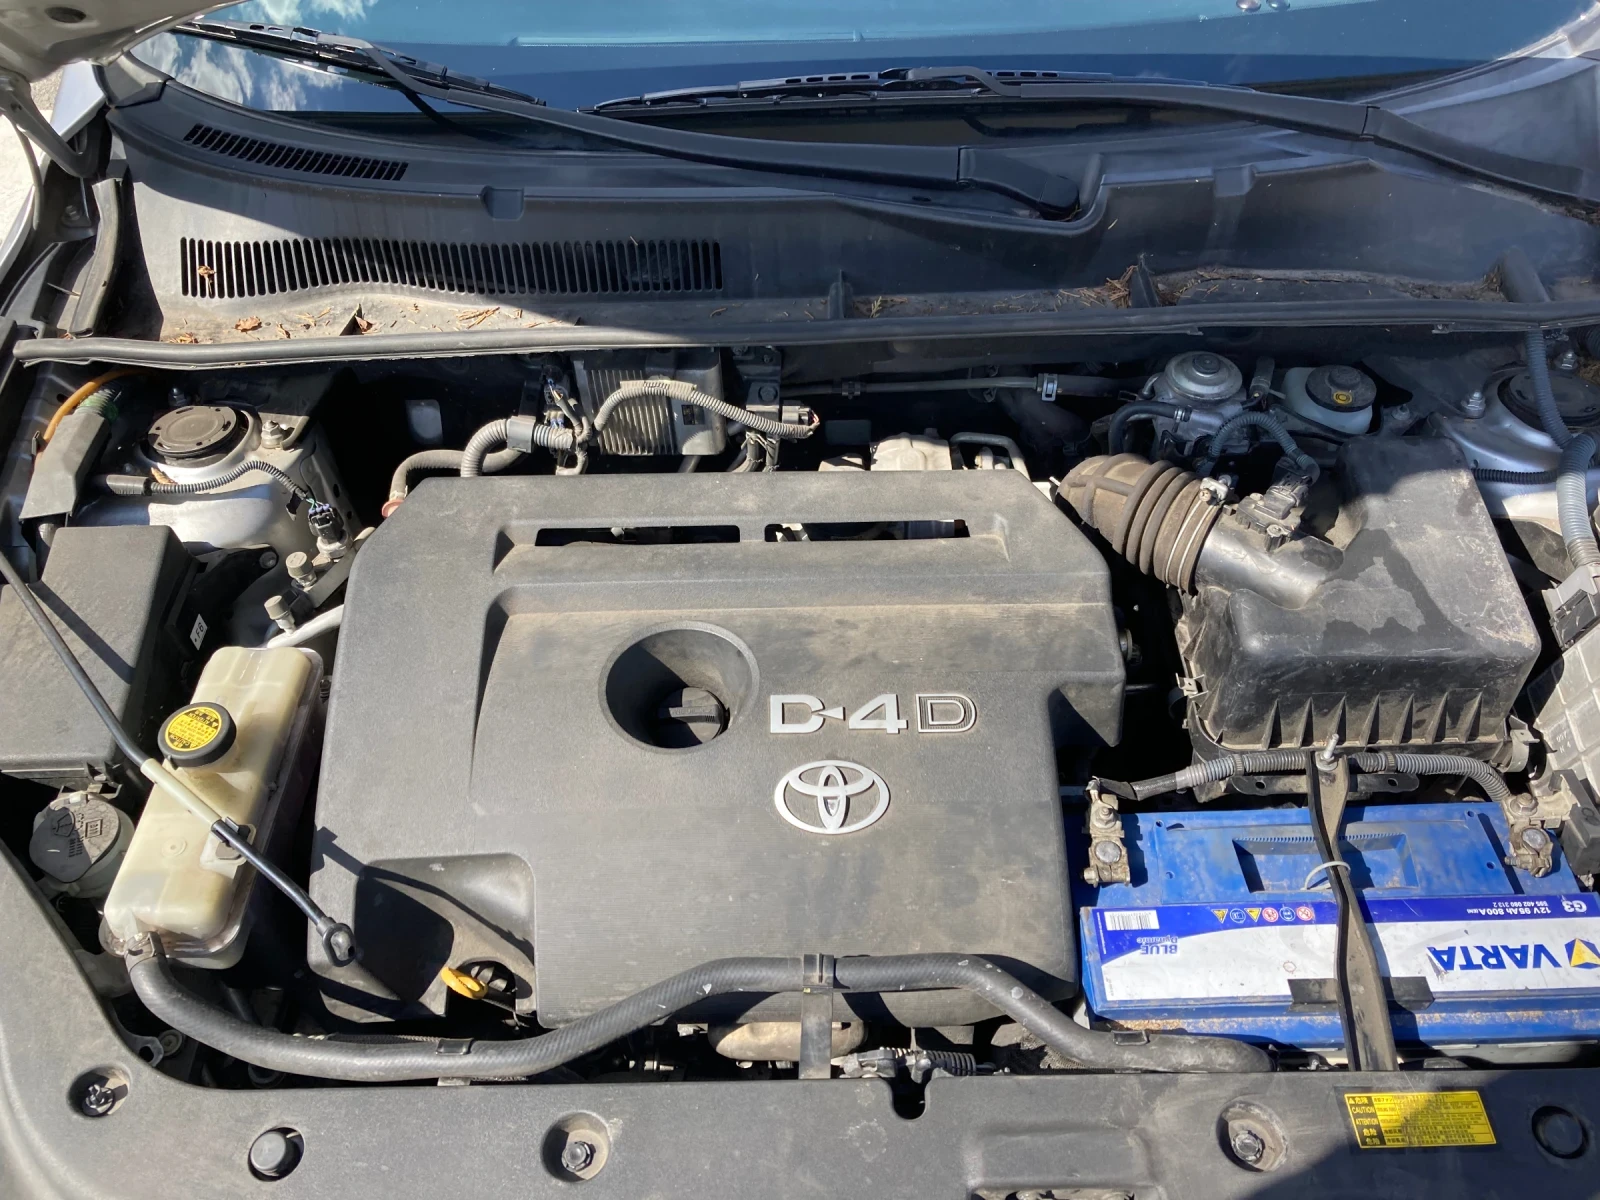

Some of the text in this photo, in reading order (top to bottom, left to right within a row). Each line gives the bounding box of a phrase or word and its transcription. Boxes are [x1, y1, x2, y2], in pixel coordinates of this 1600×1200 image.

[1533, 906, 1552, 914] 12V
[1562, 900, 1587, 913] G3
[1140, 944, 1178, 955] BLUE
[1426, 944, 1562, 971] VARTA
[1352, 1106, 1375, 1114] CAUTION
